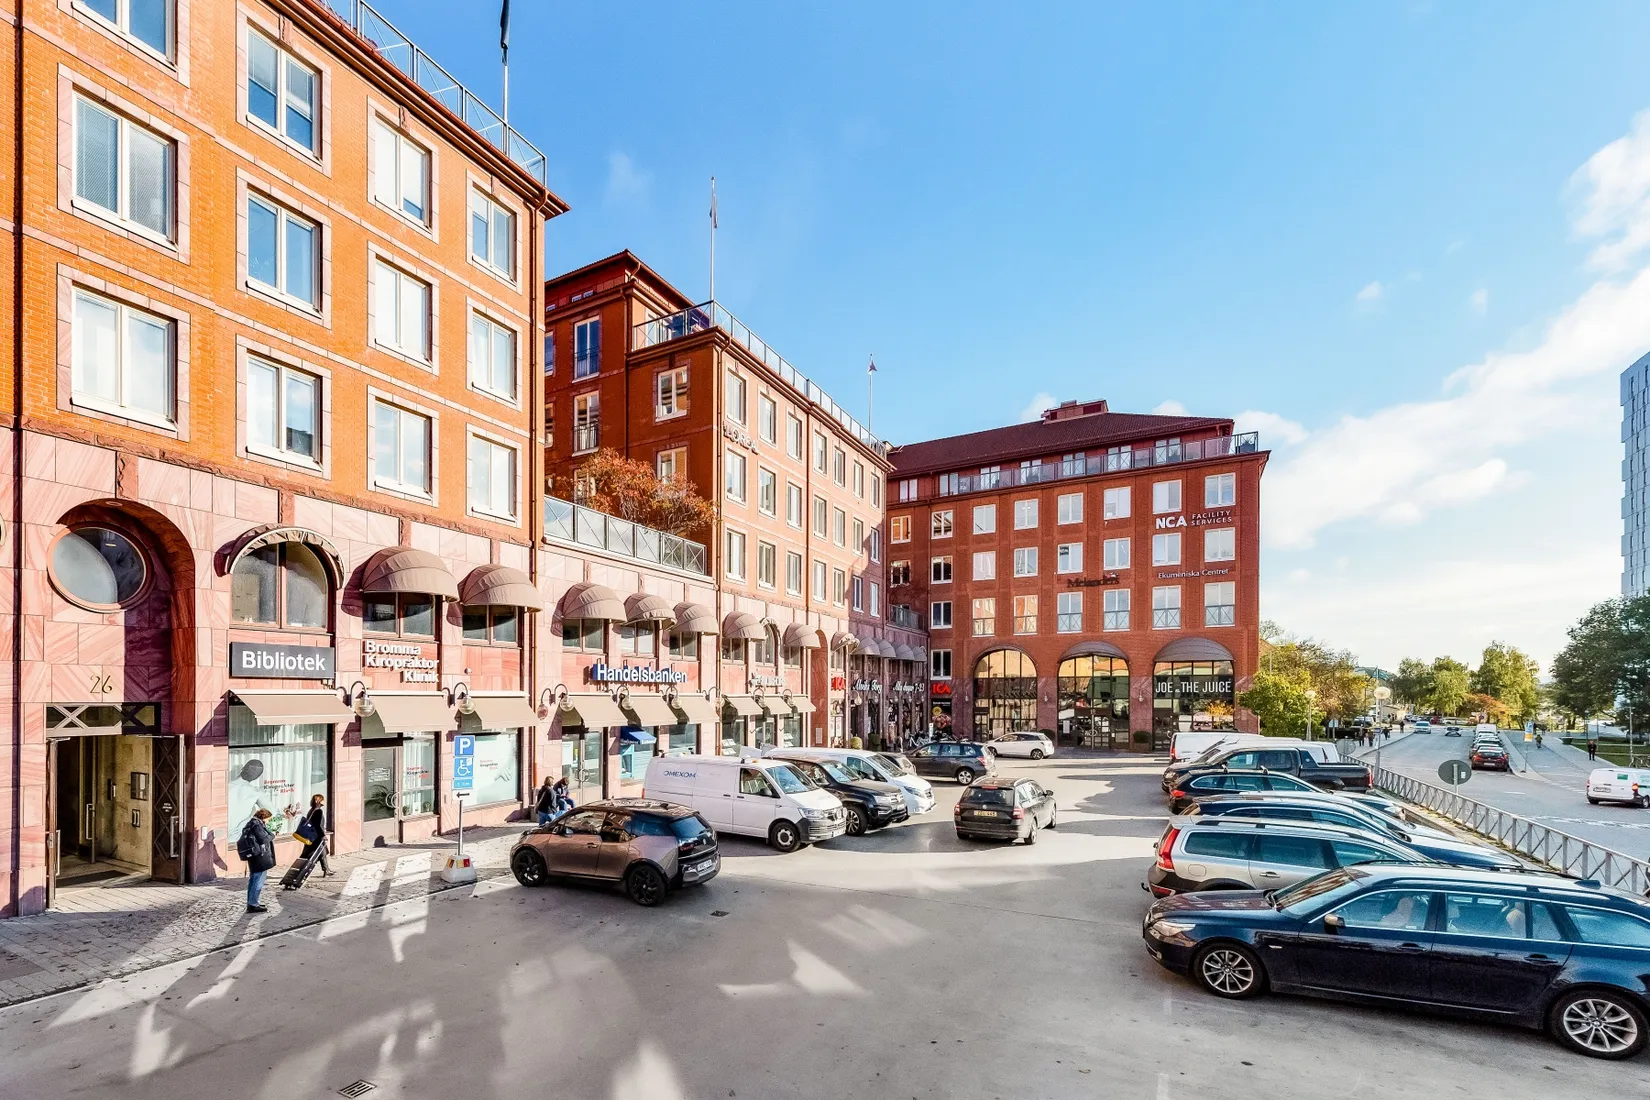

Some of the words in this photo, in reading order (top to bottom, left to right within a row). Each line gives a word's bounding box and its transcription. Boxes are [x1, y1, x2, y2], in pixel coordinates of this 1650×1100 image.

[1192, 510, 1231, 519] FACILITY
[1155, 515, 1188, 529] NCA
[1191, 517, 1232, 526] SERVICES
[1158, 570, 1200, 579] Ekumeniska
[1201, 568, 1229, 576] Centret
[365, 640, 421, 655] Bromma
[242, 650, 326, 671] Bibliotek
[365, 654, 440, 670] Kiropraktor
[403, 670, 440, 683] Klinik
[595, 663, 688, 683] Handelsbanken
[90, 674, 113, 694] 26
[932, 683, 951, 694] ICA
[1155, 681, 1173, 693] JOE
[1180, 681, 1199, 693] THE
[1202, 681, 1232, 693] JUICE
[459, 737, 471, 755] P
[663, 770, 697, 778] OMEXOM
